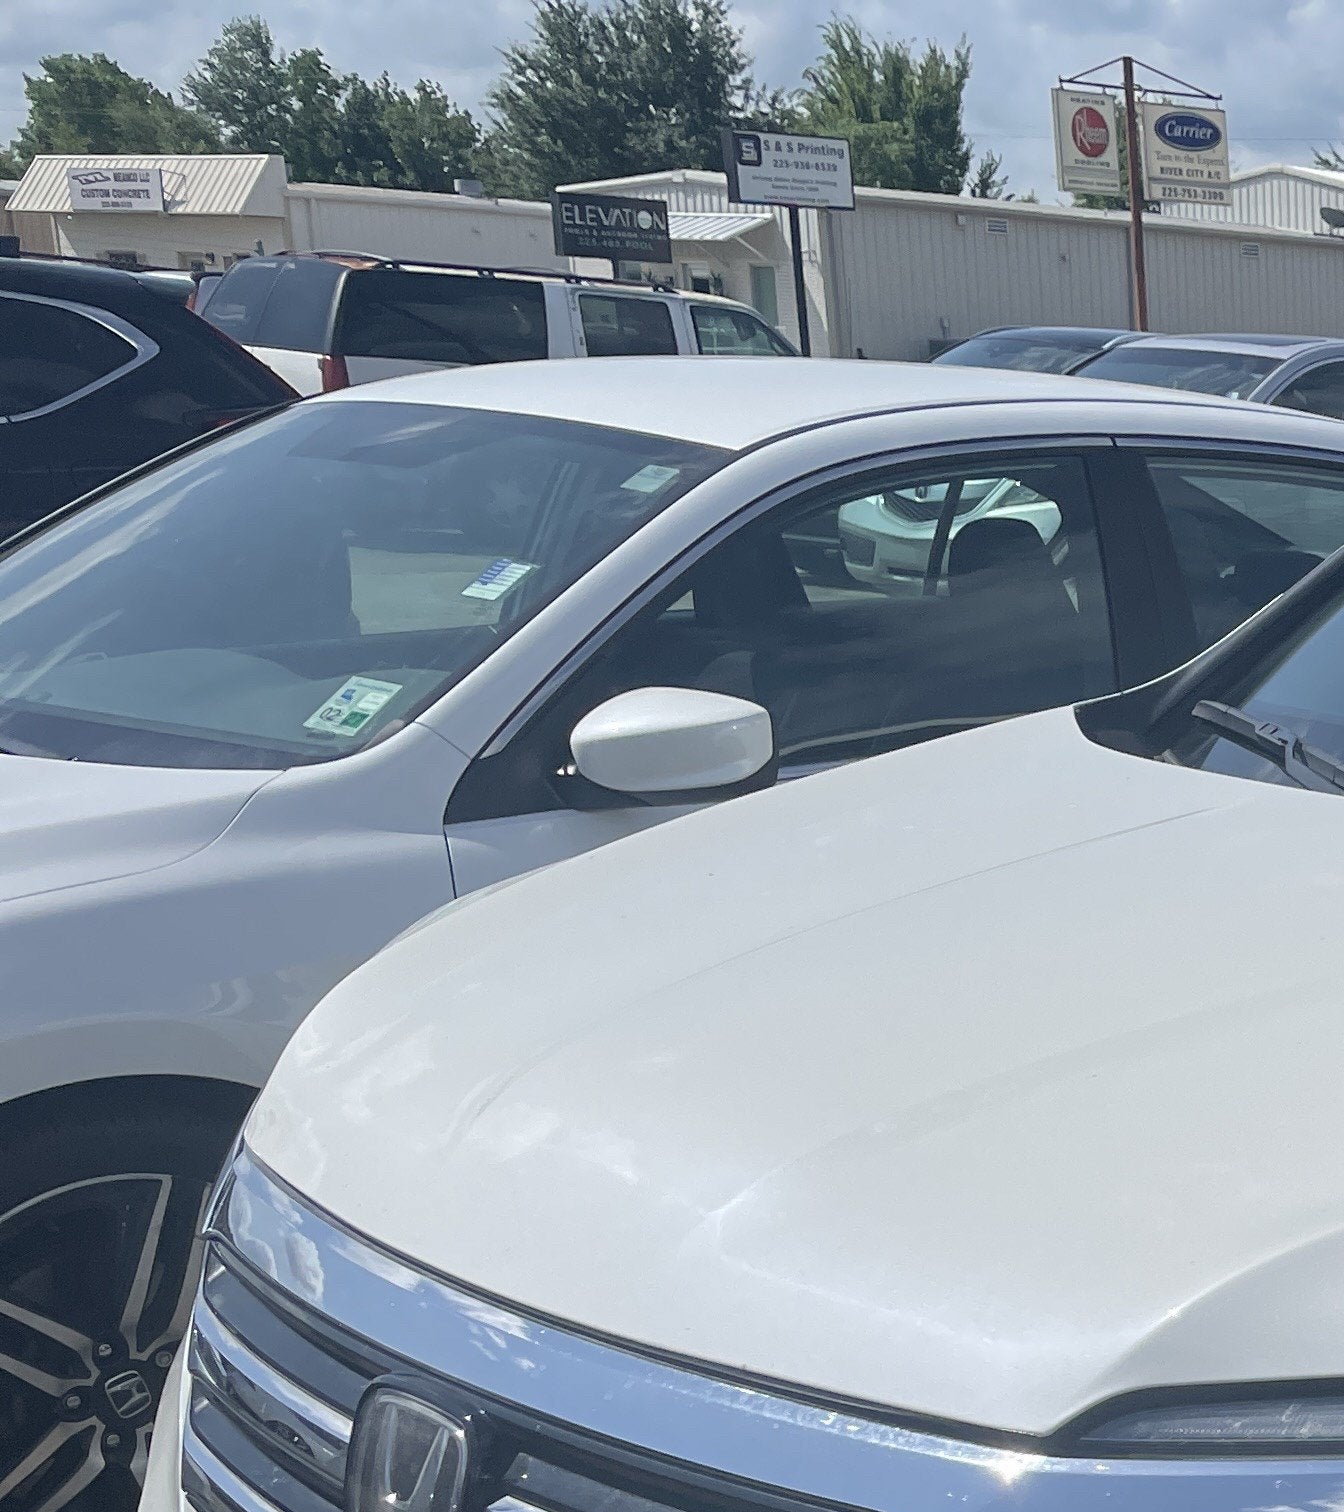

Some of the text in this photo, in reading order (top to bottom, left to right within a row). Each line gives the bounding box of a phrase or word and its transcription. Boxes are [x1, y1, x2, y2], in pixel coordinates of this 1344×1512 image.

[1076, 108, 1109, 151] Rheem
[1165, 120, 1214, 140] Carrier
[763, 139, 771, 151] S
[786, 141, 794, 153] S
[797, 142, 845, 159] Printing
[1160, 166, 1182, 176] RIVER
[1186, 168, 1204, 178] CITY
[81, 188, 150, 199] CUSTOM CONCRETE
[561, 203, 667, 230] ELEVATION
